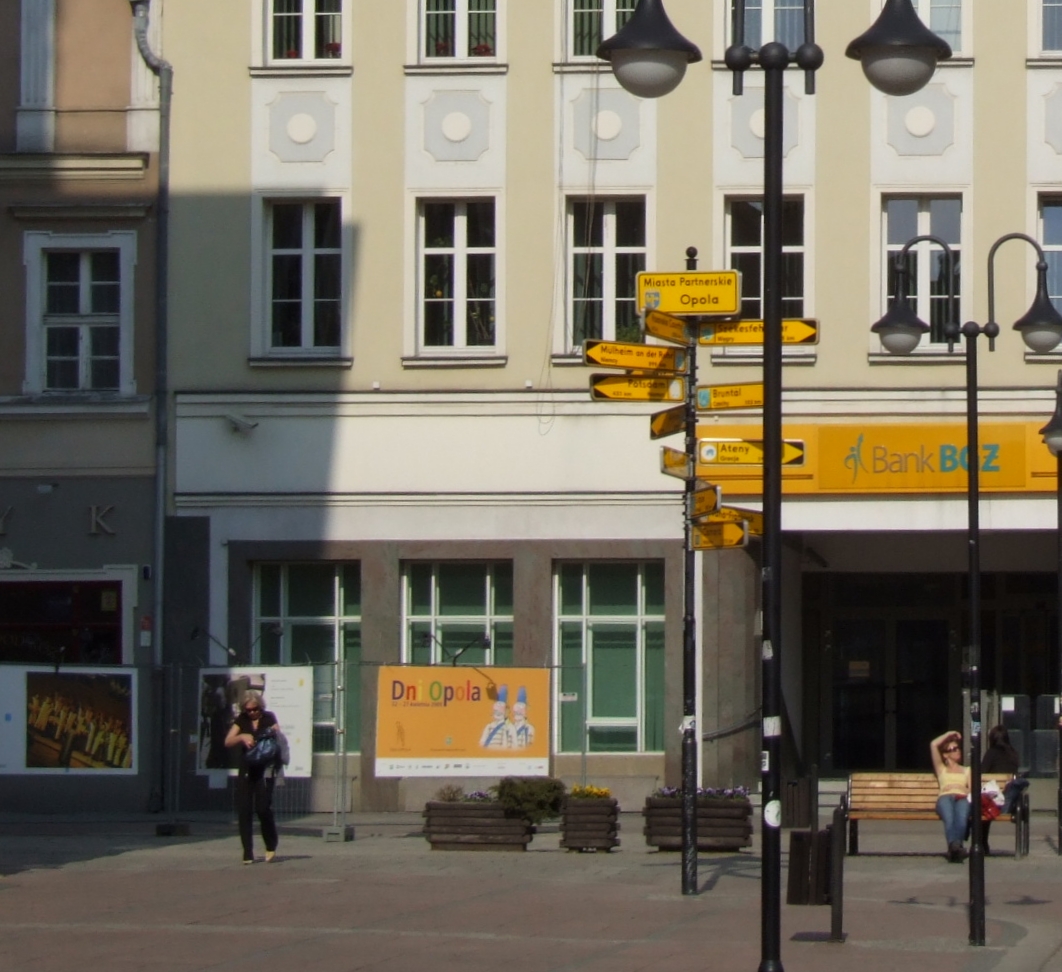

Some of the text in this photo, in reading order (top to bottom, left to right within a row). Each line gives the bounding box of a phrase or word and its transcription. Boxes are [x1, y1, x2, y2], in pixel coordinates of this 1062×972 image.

[643, 276, 732, 287] Miasta Partnerskie
[680, 294, 719, 307] Opola
[628, 379, 665, 388] Potsdam
[720, 444, 749, 454] Ateny
[872, 444, 935, 474] Bank
[392, 680, 481, 707] Dni Opola
